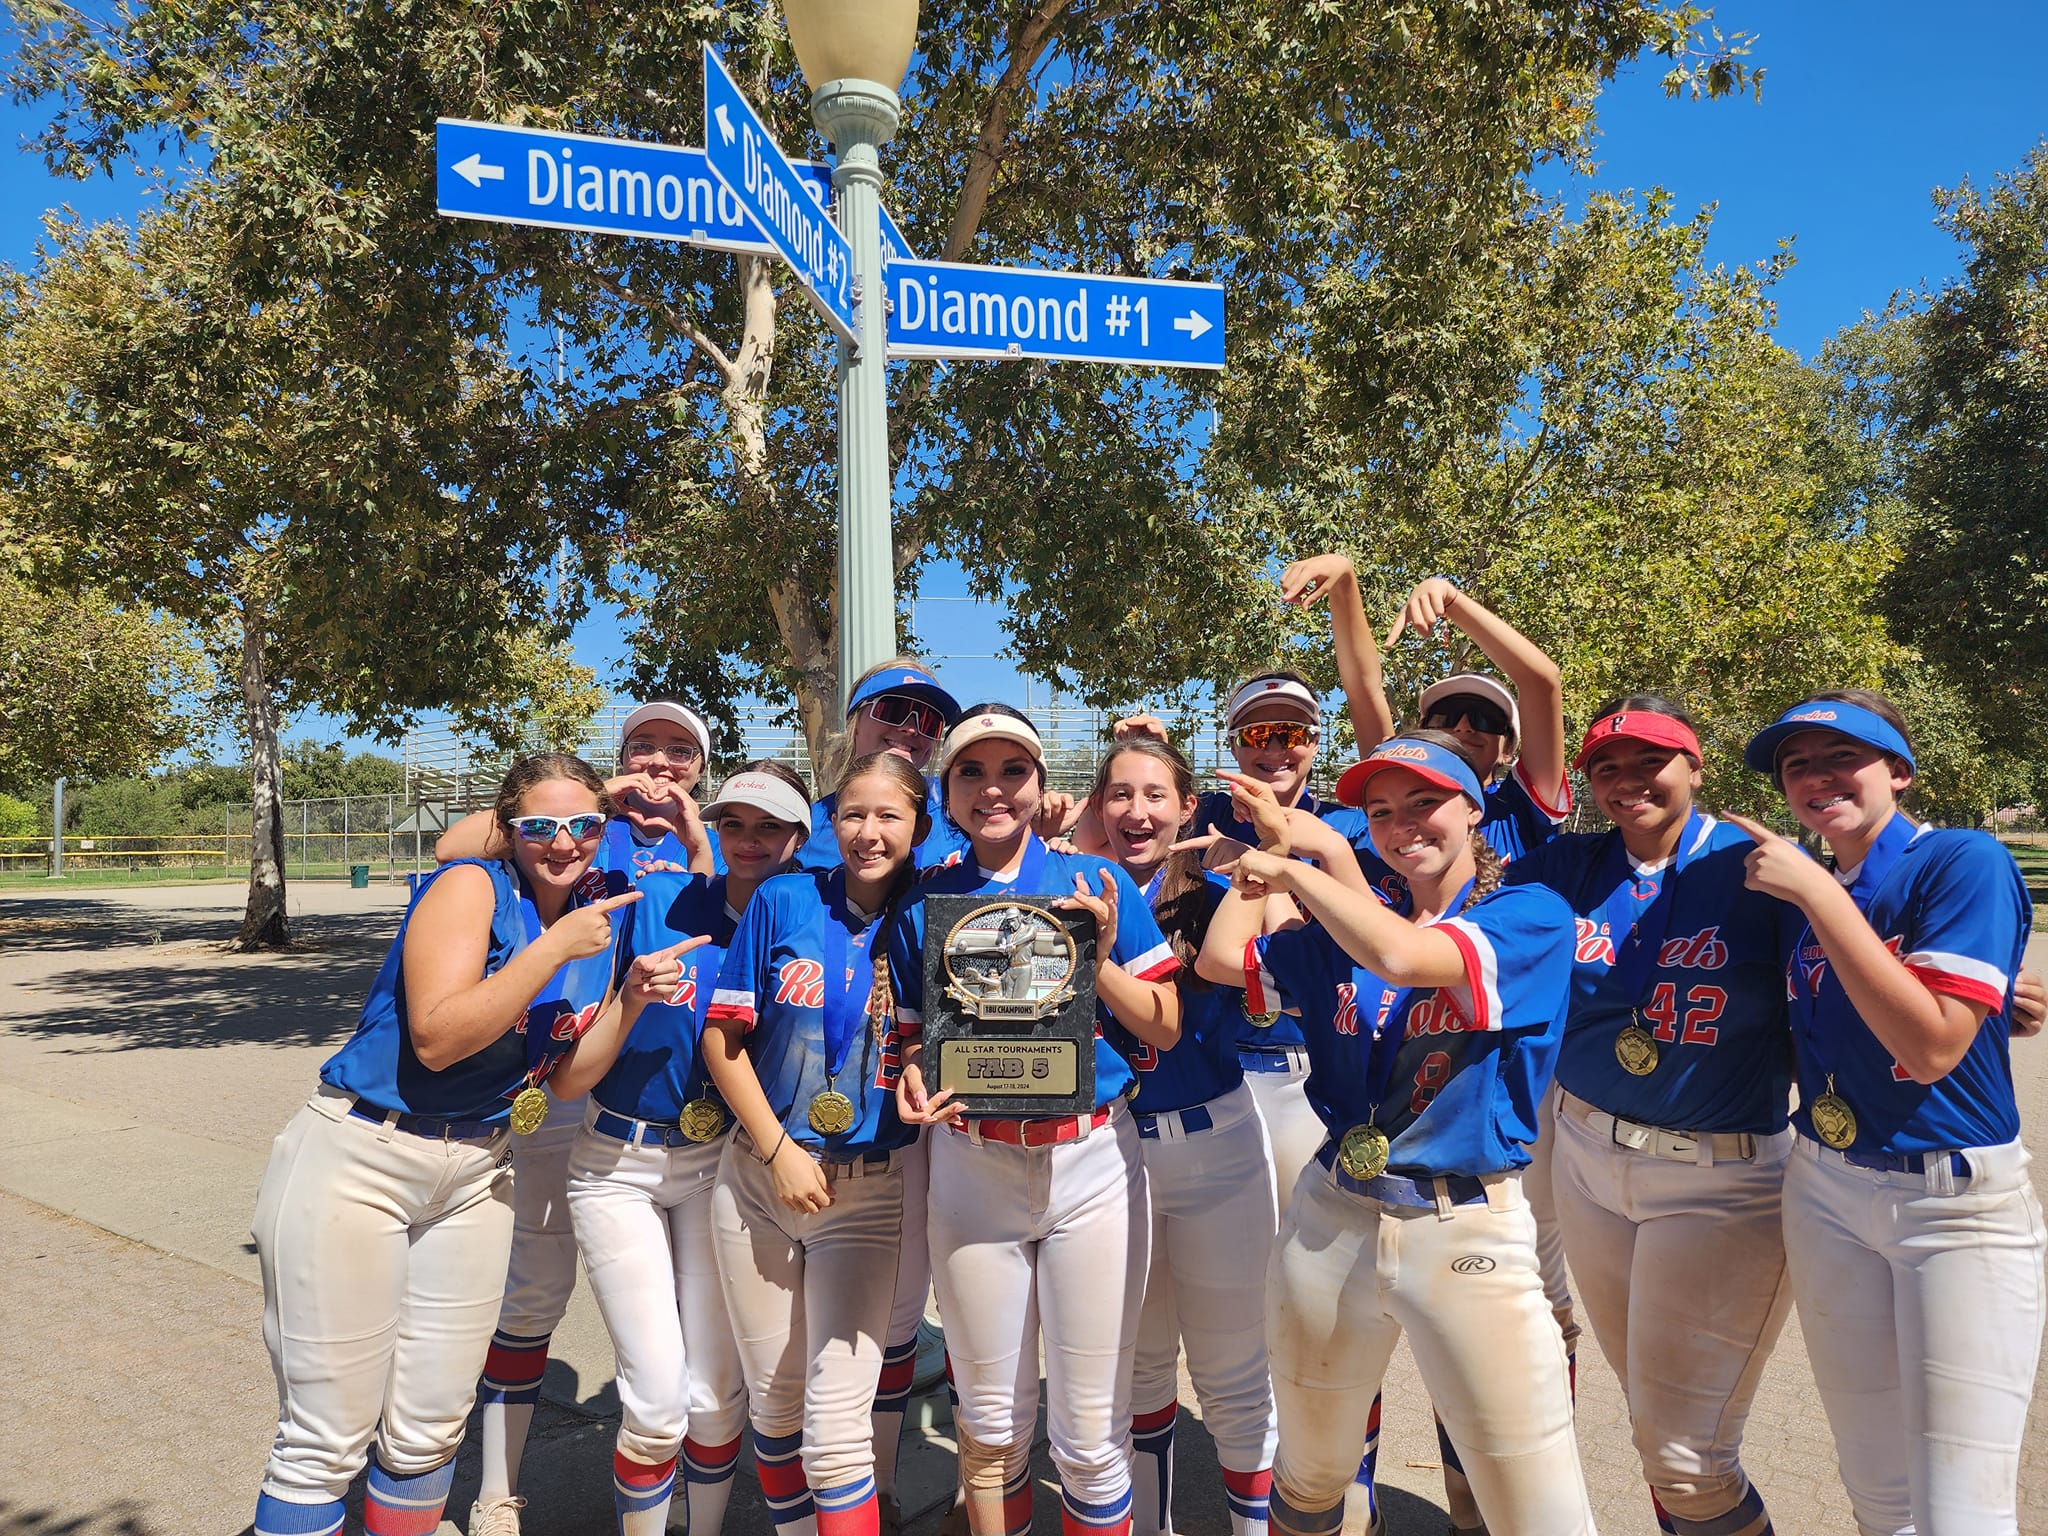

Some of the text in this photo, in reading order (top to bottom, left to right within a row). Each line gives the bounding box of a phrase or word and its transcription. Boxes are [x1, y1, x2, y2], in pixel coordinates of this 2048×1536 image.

[743, 121, 824, 283] Diamond
[828, 239, 848, 310] #2
[899, 274, 1149, 347] Diamond #1
[997, 1005, 1033, 1015] CHAMPIONS
[1643, 982, 1728, 1046] 42
[954, 1046, 1062, 1054] ALL STAR TOURNAMENTS
[968, 1058, 1049, 1079] FAB 5
[1410, 1051, 1451, 1115] 8
